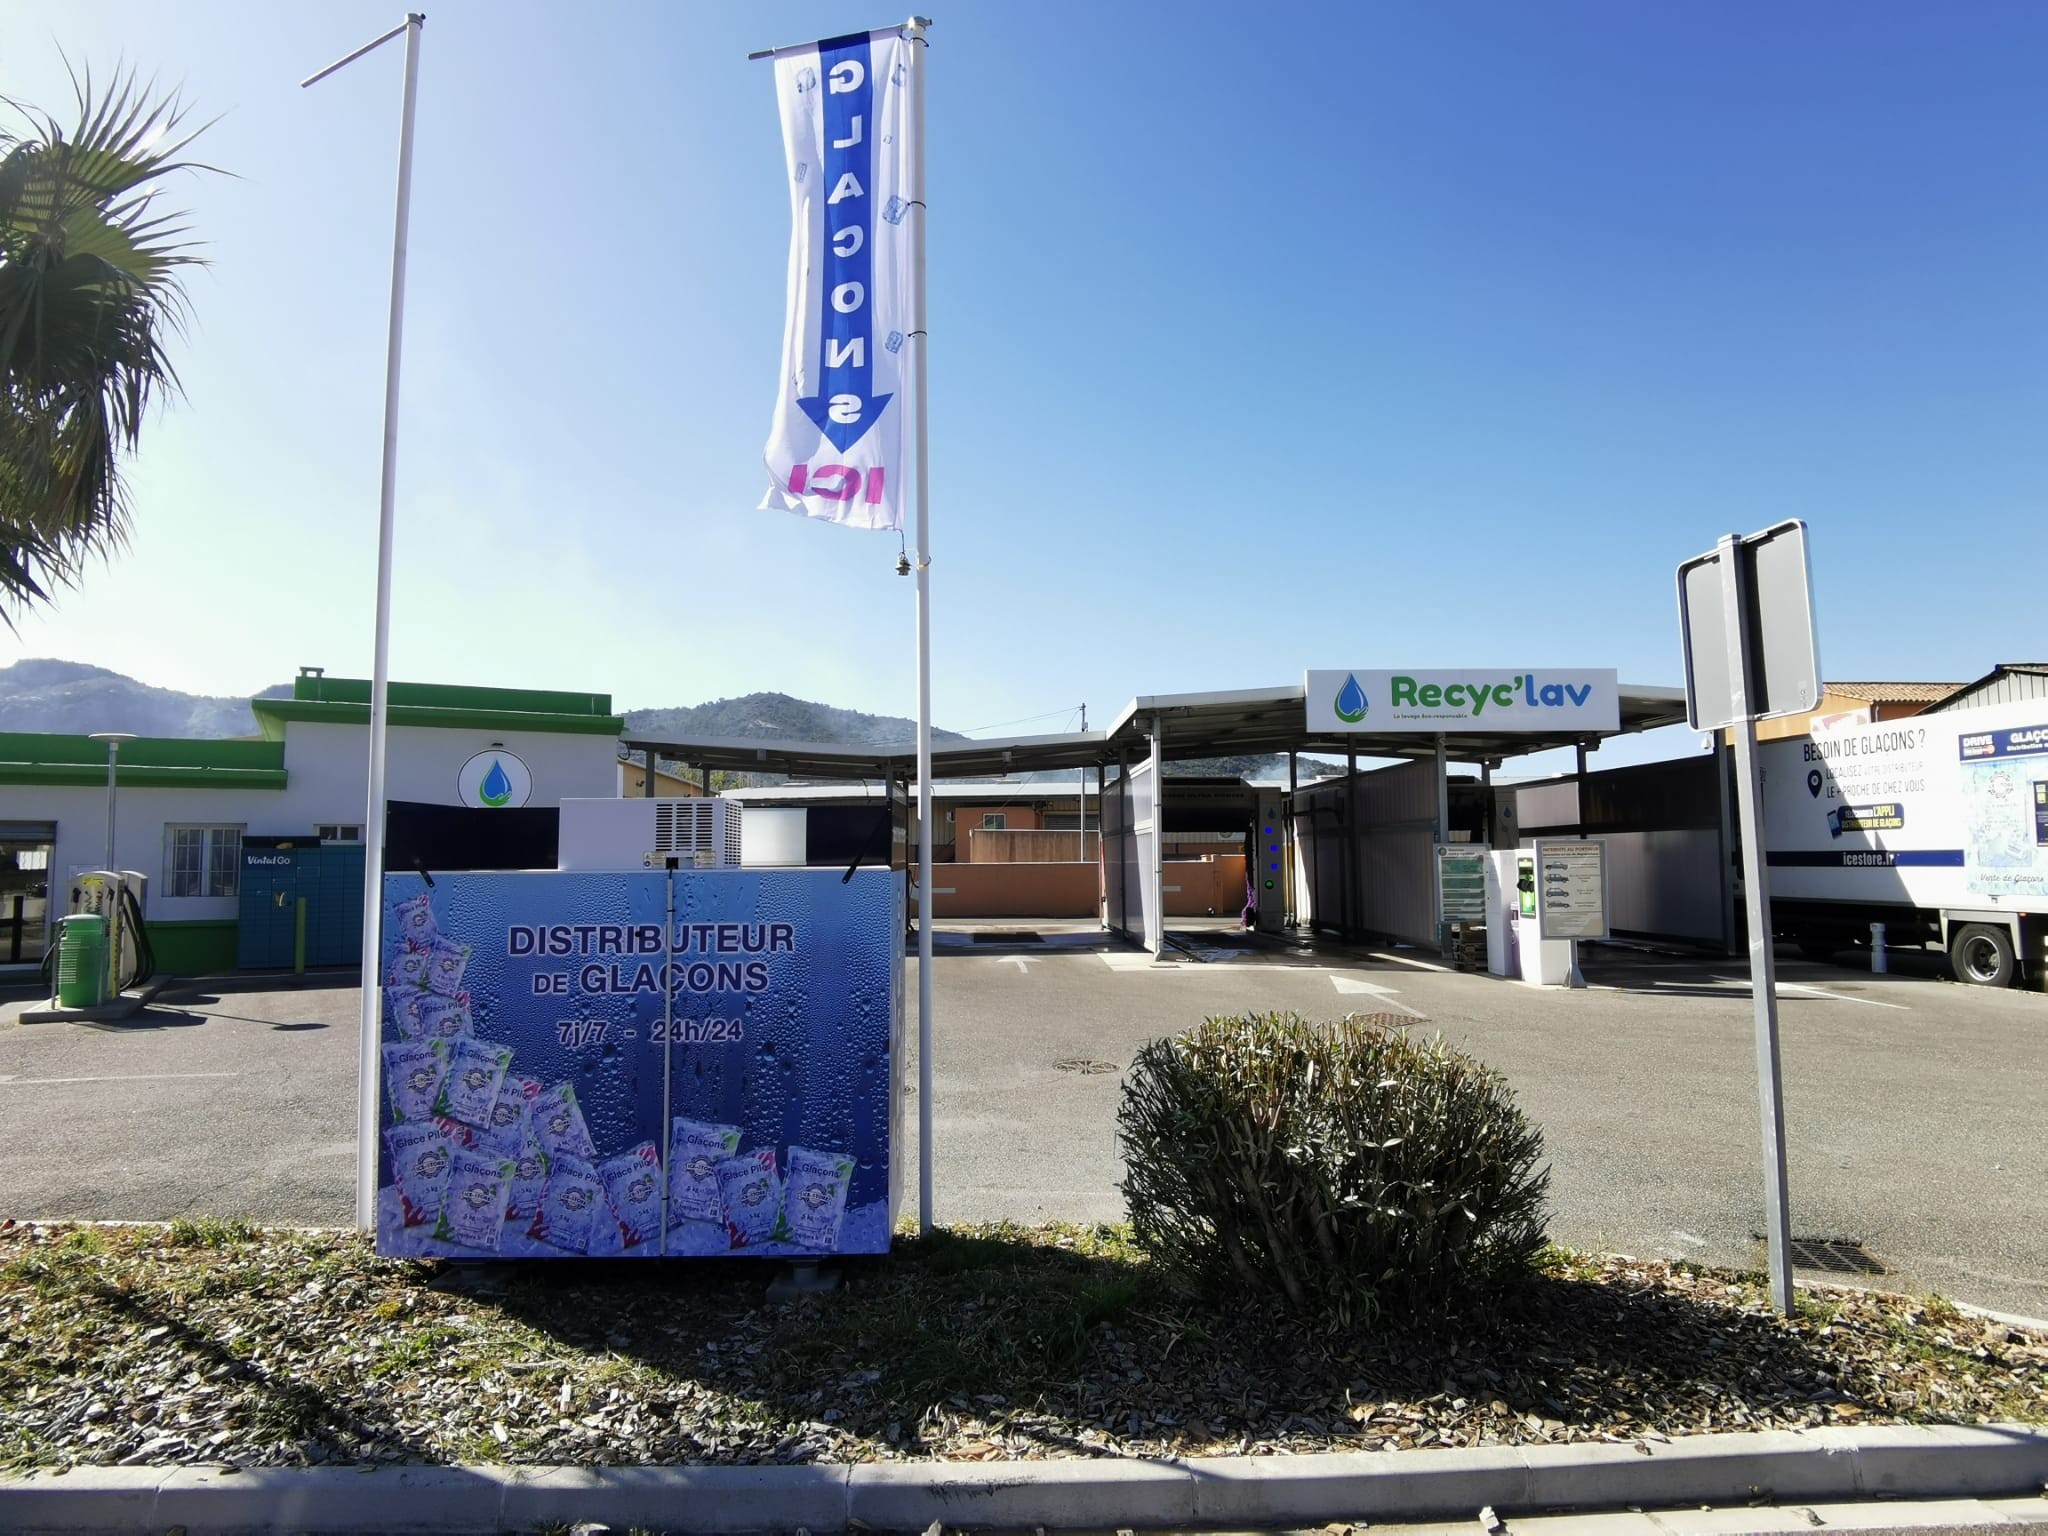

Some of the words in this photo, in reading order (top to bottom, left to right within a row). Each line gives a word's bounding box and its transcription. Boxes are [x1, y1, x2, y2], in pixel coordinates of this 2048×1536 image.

[1390, 674, 1592, 716] Recyc'lav
[1803, 739, 1841, 762] BESOIN
[1844, 737, 1858, 757] DE
[1918, 728, 1926, 748] ?
[1963, 734, 1993, 747] DRIVE
[1825, 763, 1862, 780] LOCALISEZ
[1826, 786, 1835, 799] LE
[1842, 783, 1870, 798] PROCHE
[1871, 782, 1881, 795] DE
[1882, 779, 1902, 795] CHEZ
[1904, 778, 1925, 793] VOUS
[277, 856, 291, 865] Go
[508, 923, 796, 956] DISTRIBUTEUR
[532, 973, 569, 994] DE
[579, 961, 769, 1000] GLAÇONS
[557, 1020, 609, 1048] 7j/7
[651, 1019, 743, 1043] 24h/24
[688, 1134, 728, 1150] Glaçons
[464, 1162, 504, 1178] Glaçons
[802, 1163, 841, 1178] Glaçons
